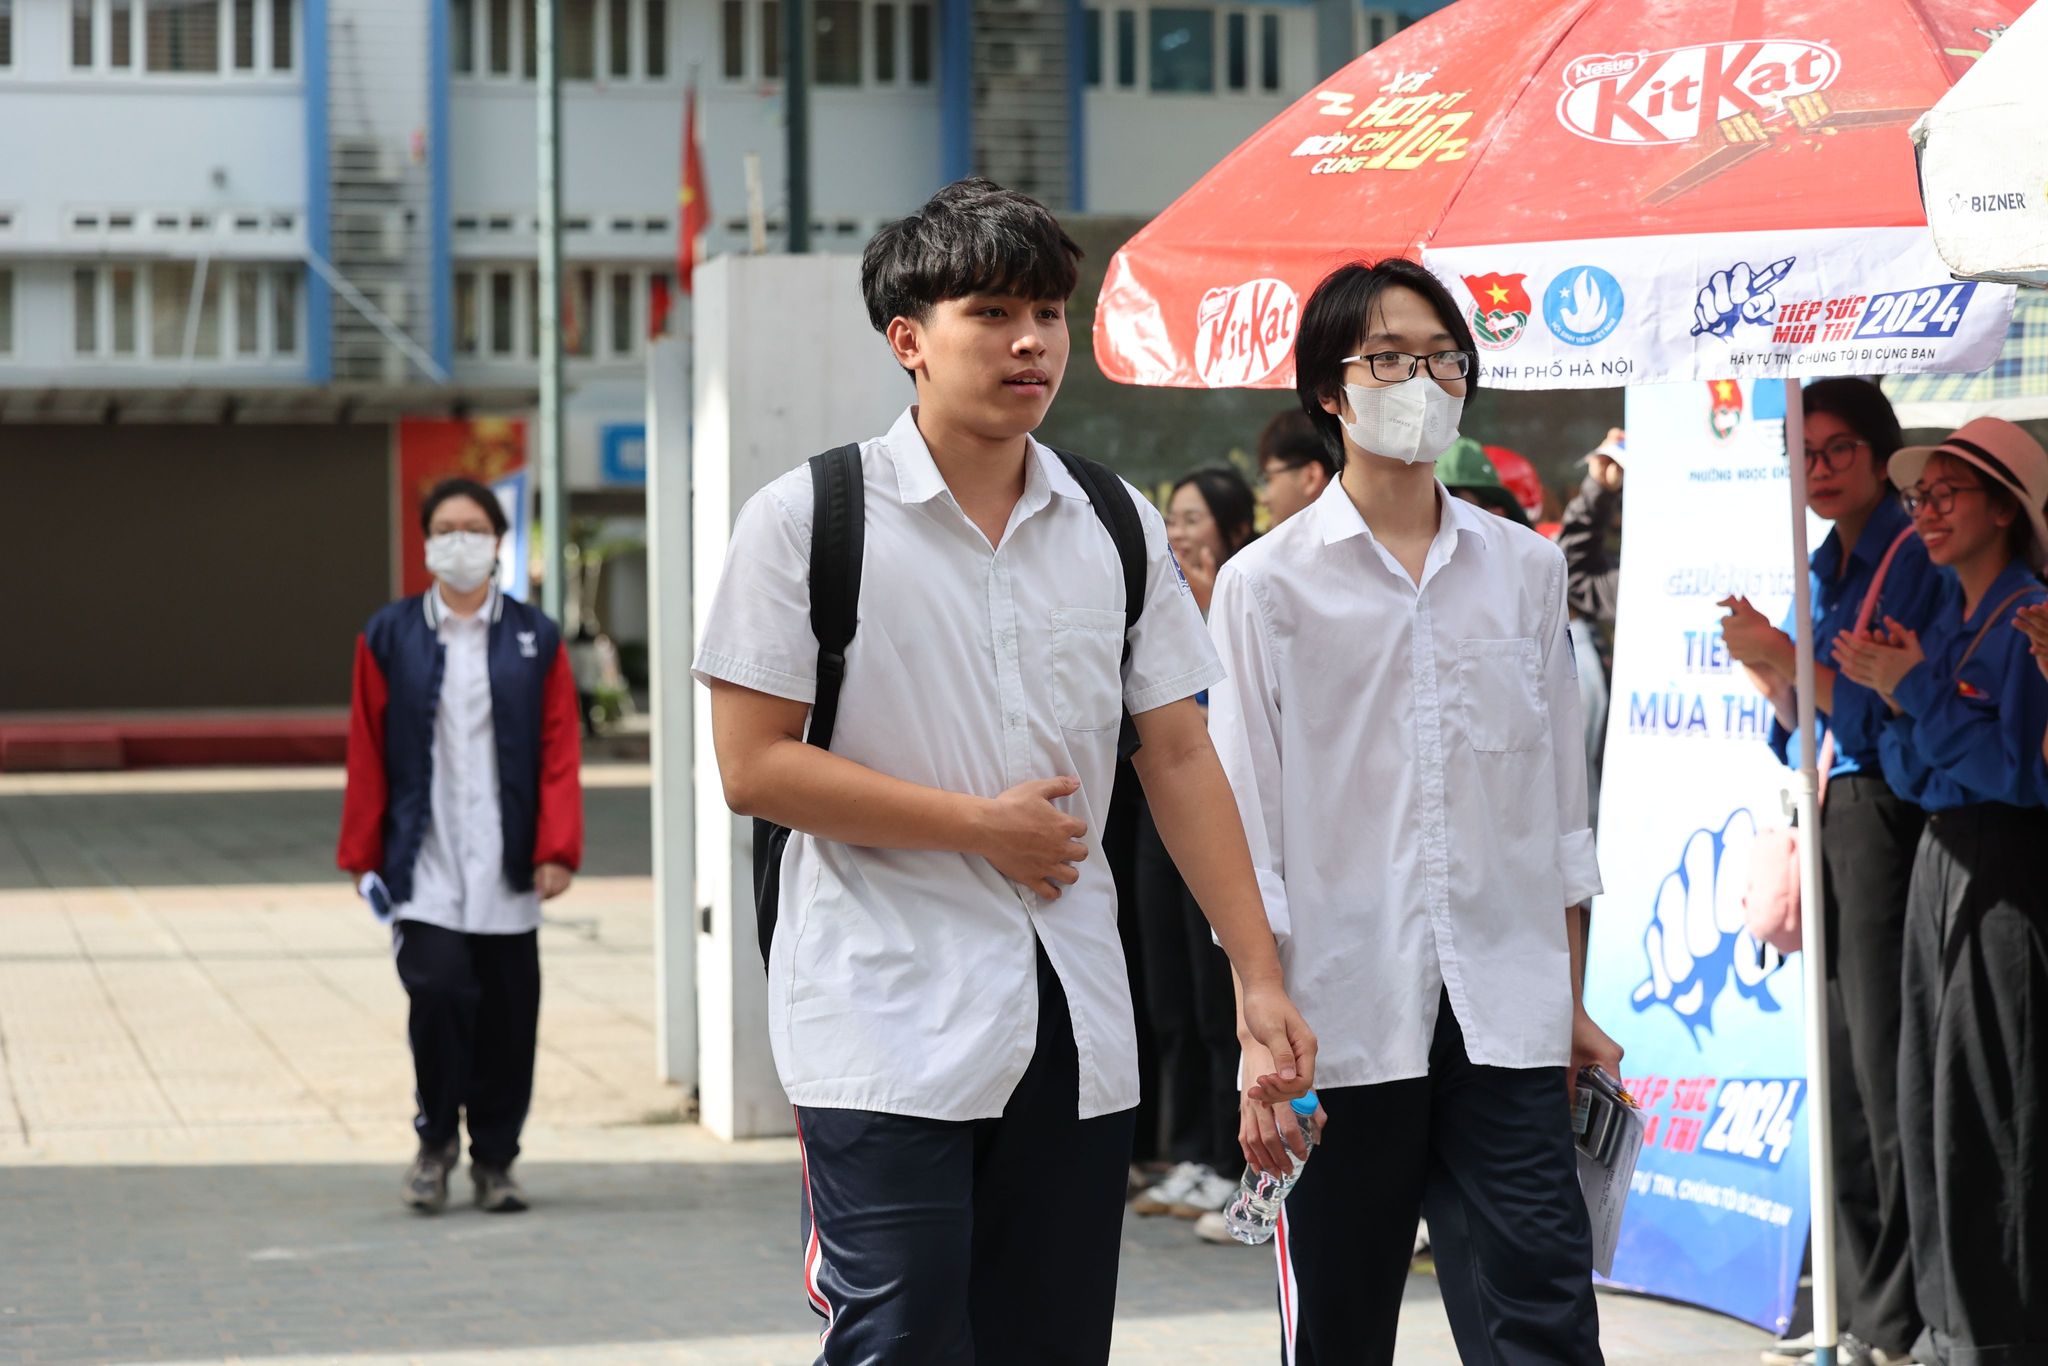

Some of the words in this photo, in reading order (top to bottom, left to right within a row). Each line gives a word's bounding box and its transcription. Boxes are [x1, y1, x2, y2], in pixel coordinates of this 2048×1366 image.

[1593, 43, 1822, 141] KitKat
[1971, 193, 2026, 212] BIZNER
[1204, 283, 1294, 383] KitKat
[1777, 299, 1822, 323] TIẾP
[1825, 294, 1867, 320] SỨC
[1857, 283, 1964, 337] 2024
[1821, 321, 1855, 343] THI
[1479, 363, 1517, 379] ÀNH
[1524, 359, 1563, 378] PHỐ
[1570, 359, 1595, 377] HÀ
[1601, 357, 1634, 377] NỘI
[1757, 352, 1772, 366] TỰ
[1797, 350, 1836, 365] CHÚNG
[1861, 349, 1872, 360] ĐI
[1875, 346, 1907, 359] CÙNG
[1911, 348, 1936, 361] BẠN
[1629, 684, 1708, 732] MÙA
[1722, 695, 1770, 737] THI
[1702, 1080, 1801, 1164] 2024
